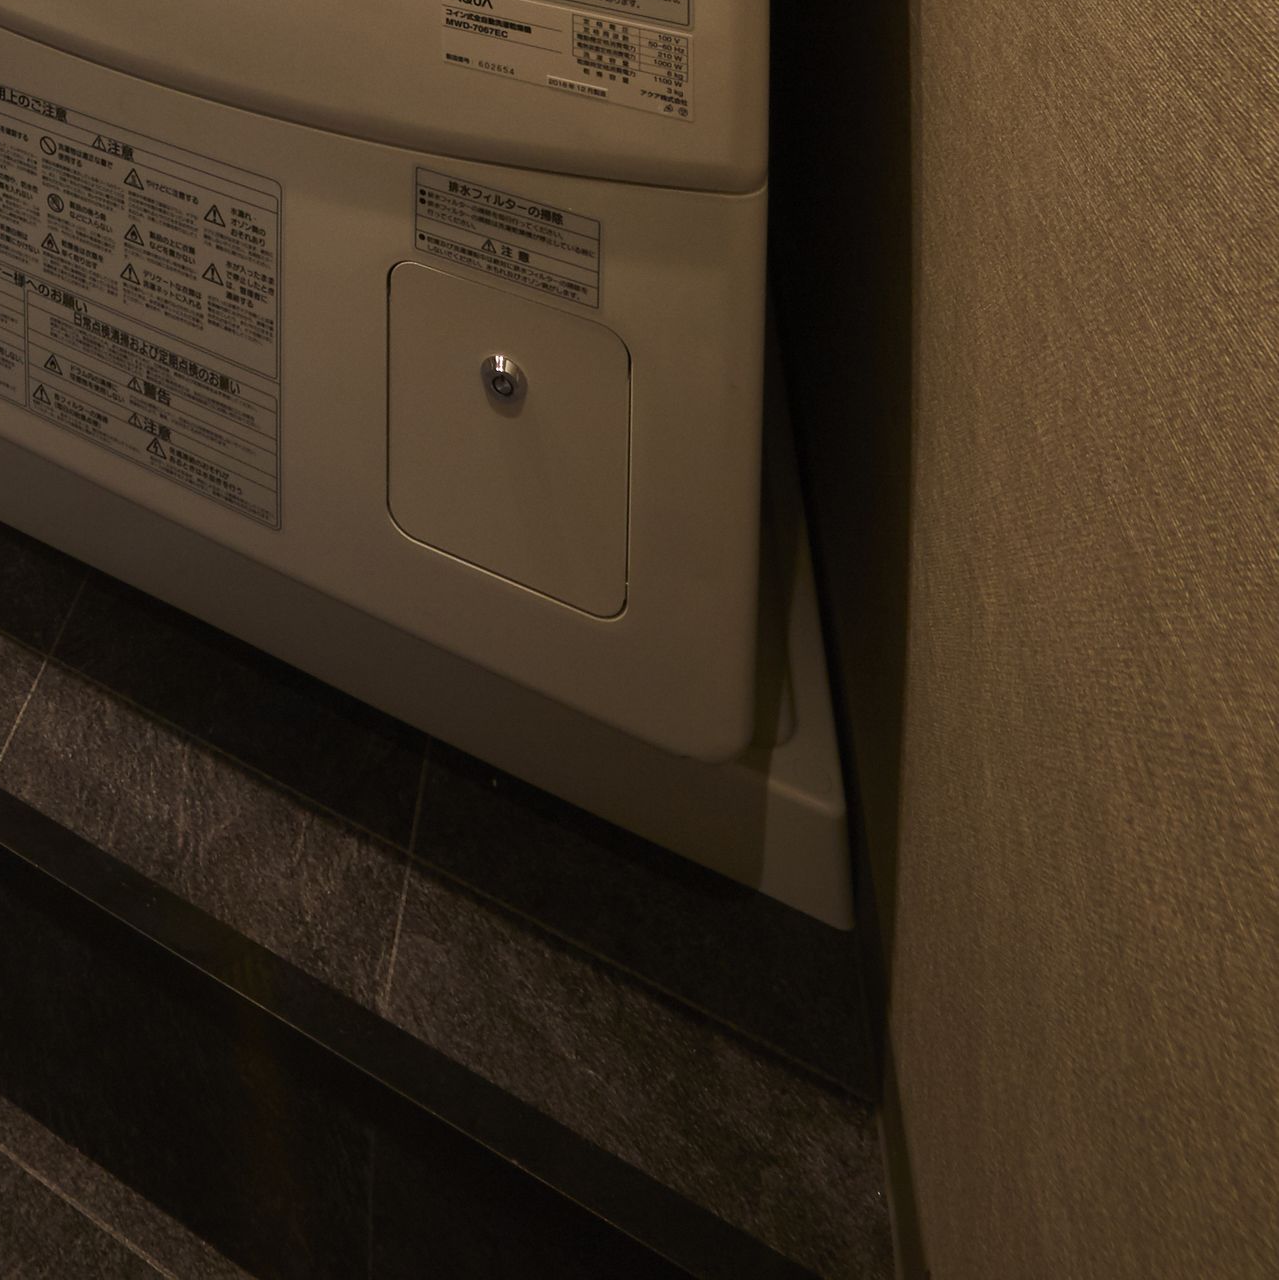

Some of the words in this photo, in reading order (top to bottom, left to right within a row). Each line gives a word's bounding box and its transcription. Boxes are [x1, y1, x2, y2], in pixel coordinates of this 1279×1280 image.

[107, 137, 135, 164] 注意
[448, 180, 565, 225] 排水フィルターの掃除
